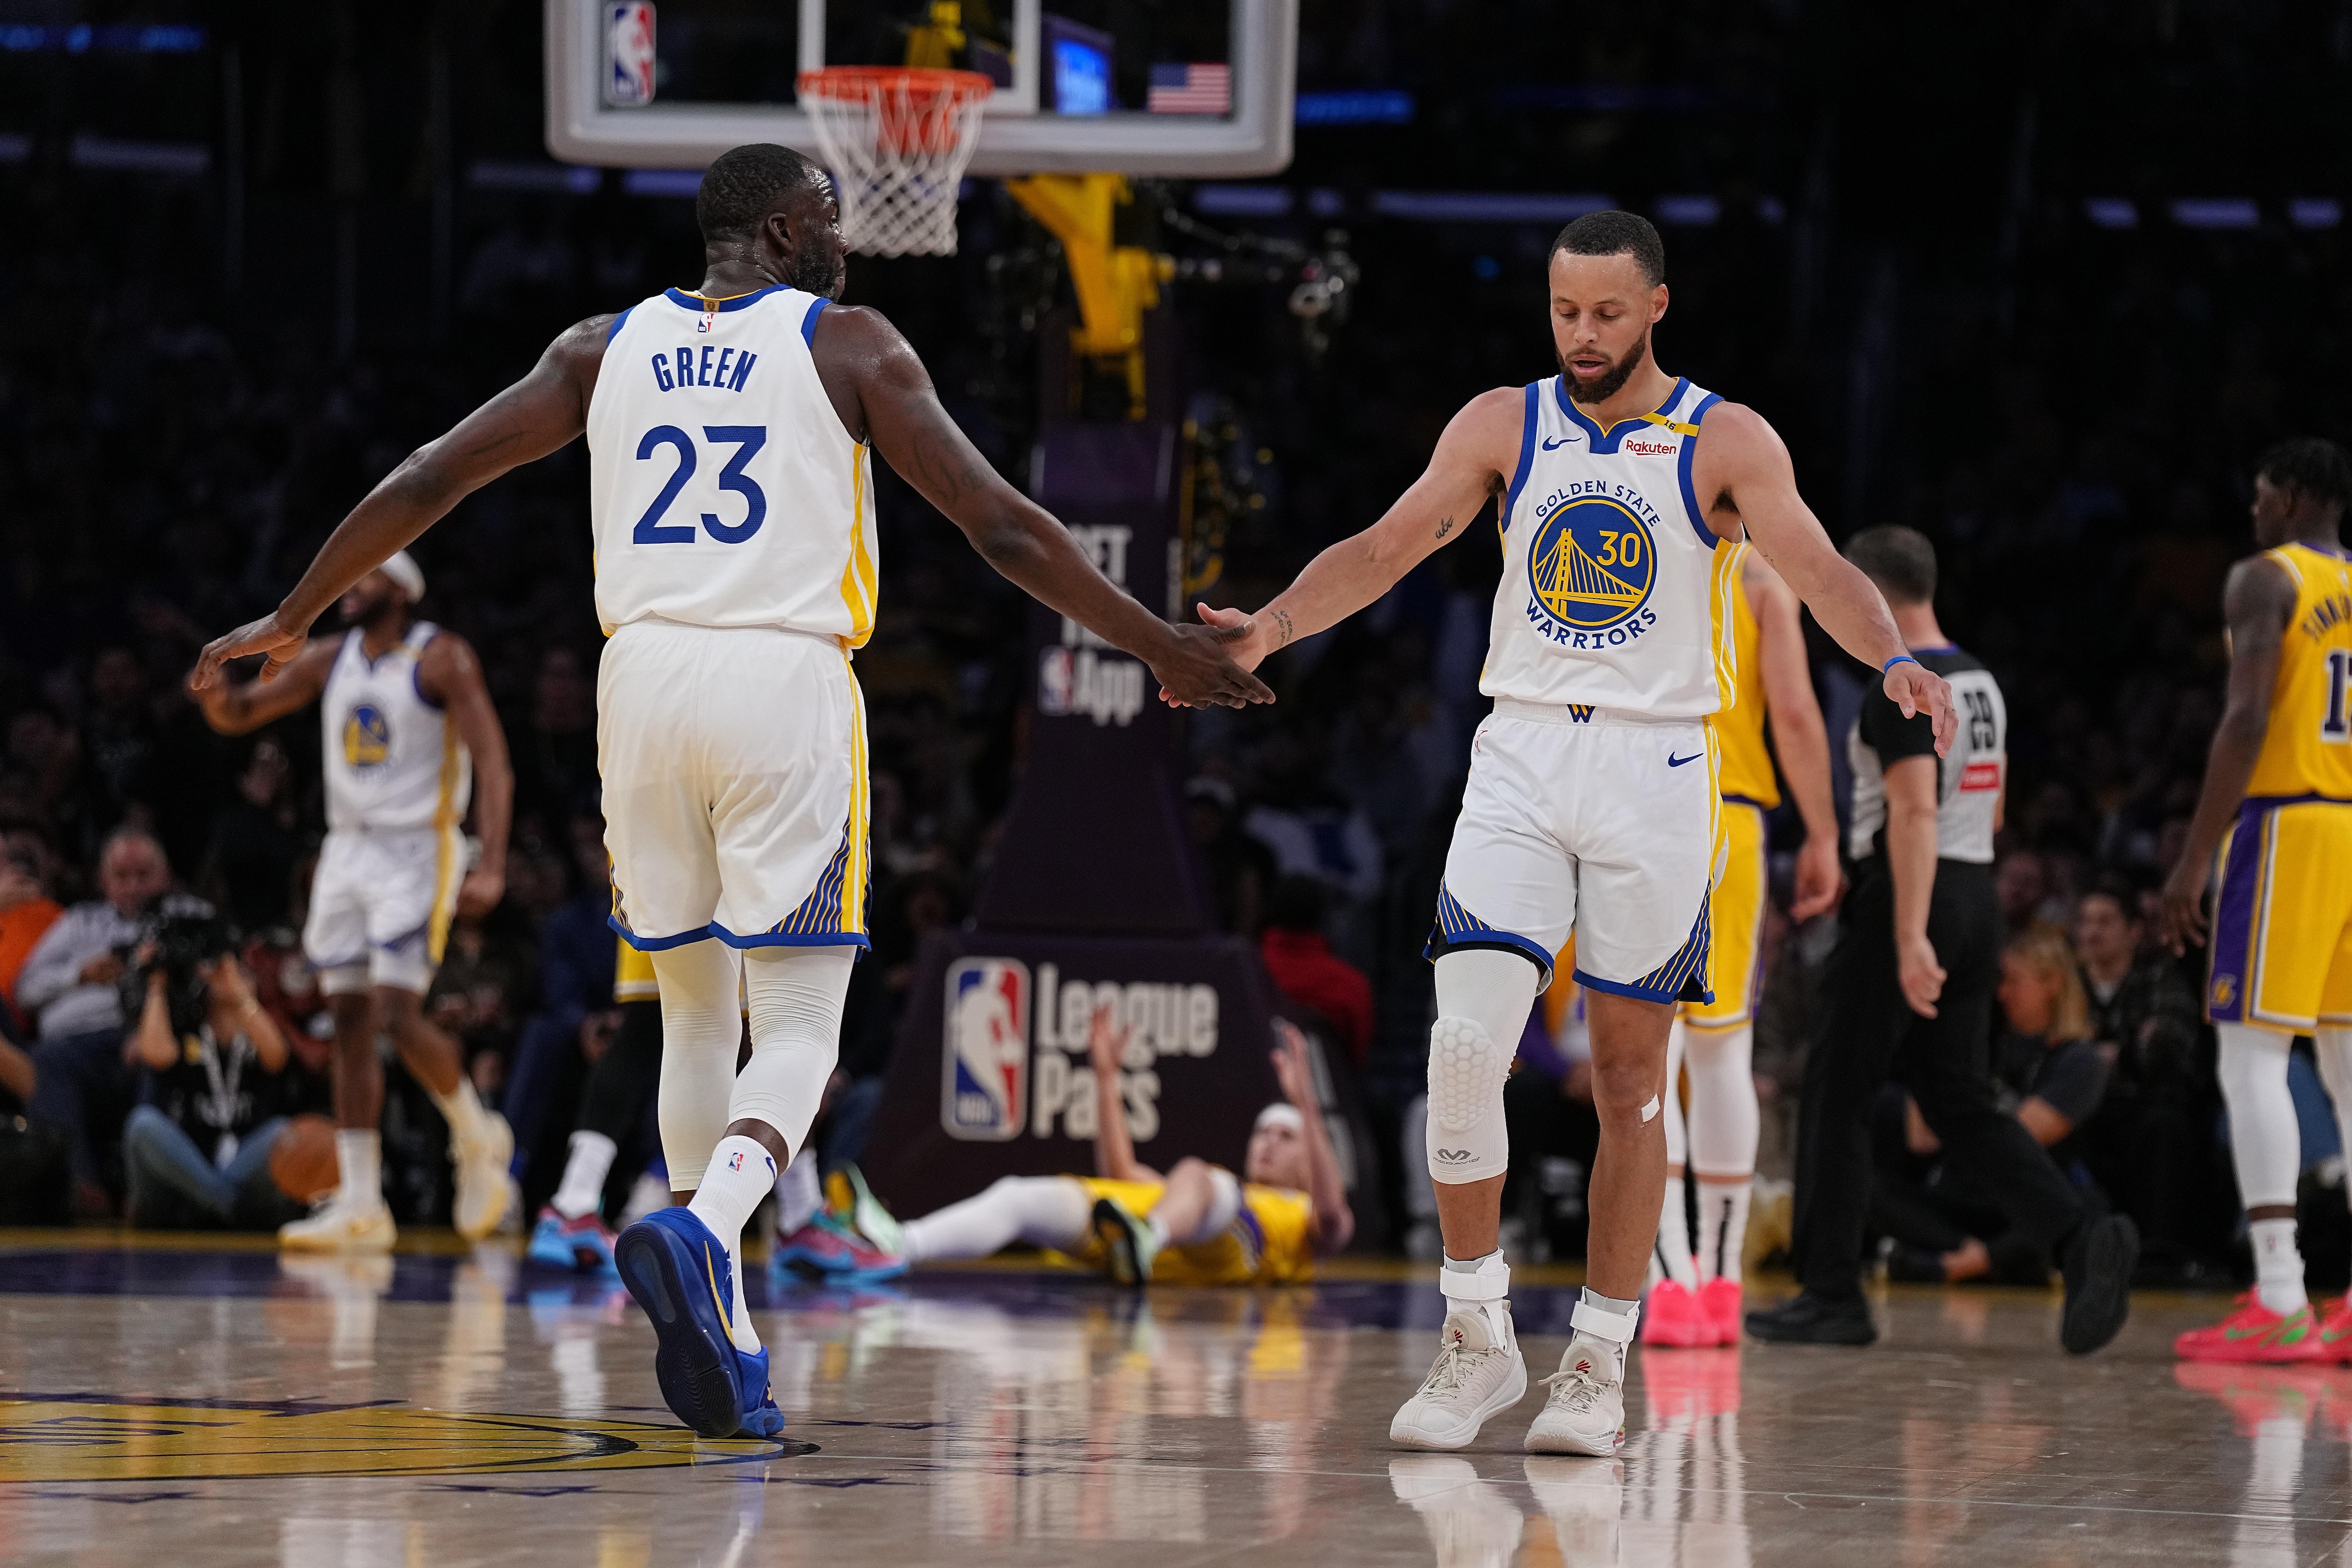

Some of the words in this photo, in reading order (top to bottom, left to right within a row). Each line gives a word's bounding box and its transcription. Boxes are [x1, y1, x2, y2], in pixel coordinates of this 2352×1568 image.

[652, 346, 758, 393] GREEN
[1626, 439, 1677, 454] Rakuten
[1664, 420, 1676, 430] 16
[633, 425, 767, 544] 23
[1535, 480, 1606, 517] GOLDEN
[1615, 485, 1661, 526] STATE
[1597, 530, 1641, 567] 30
[1526, 596, 1657, 649] WARRIORS
[2322, 647, 2352, 742] 1
[1037, 962, 1219, 1068] League
[1033, 1053, 1161, 1142] Pas
